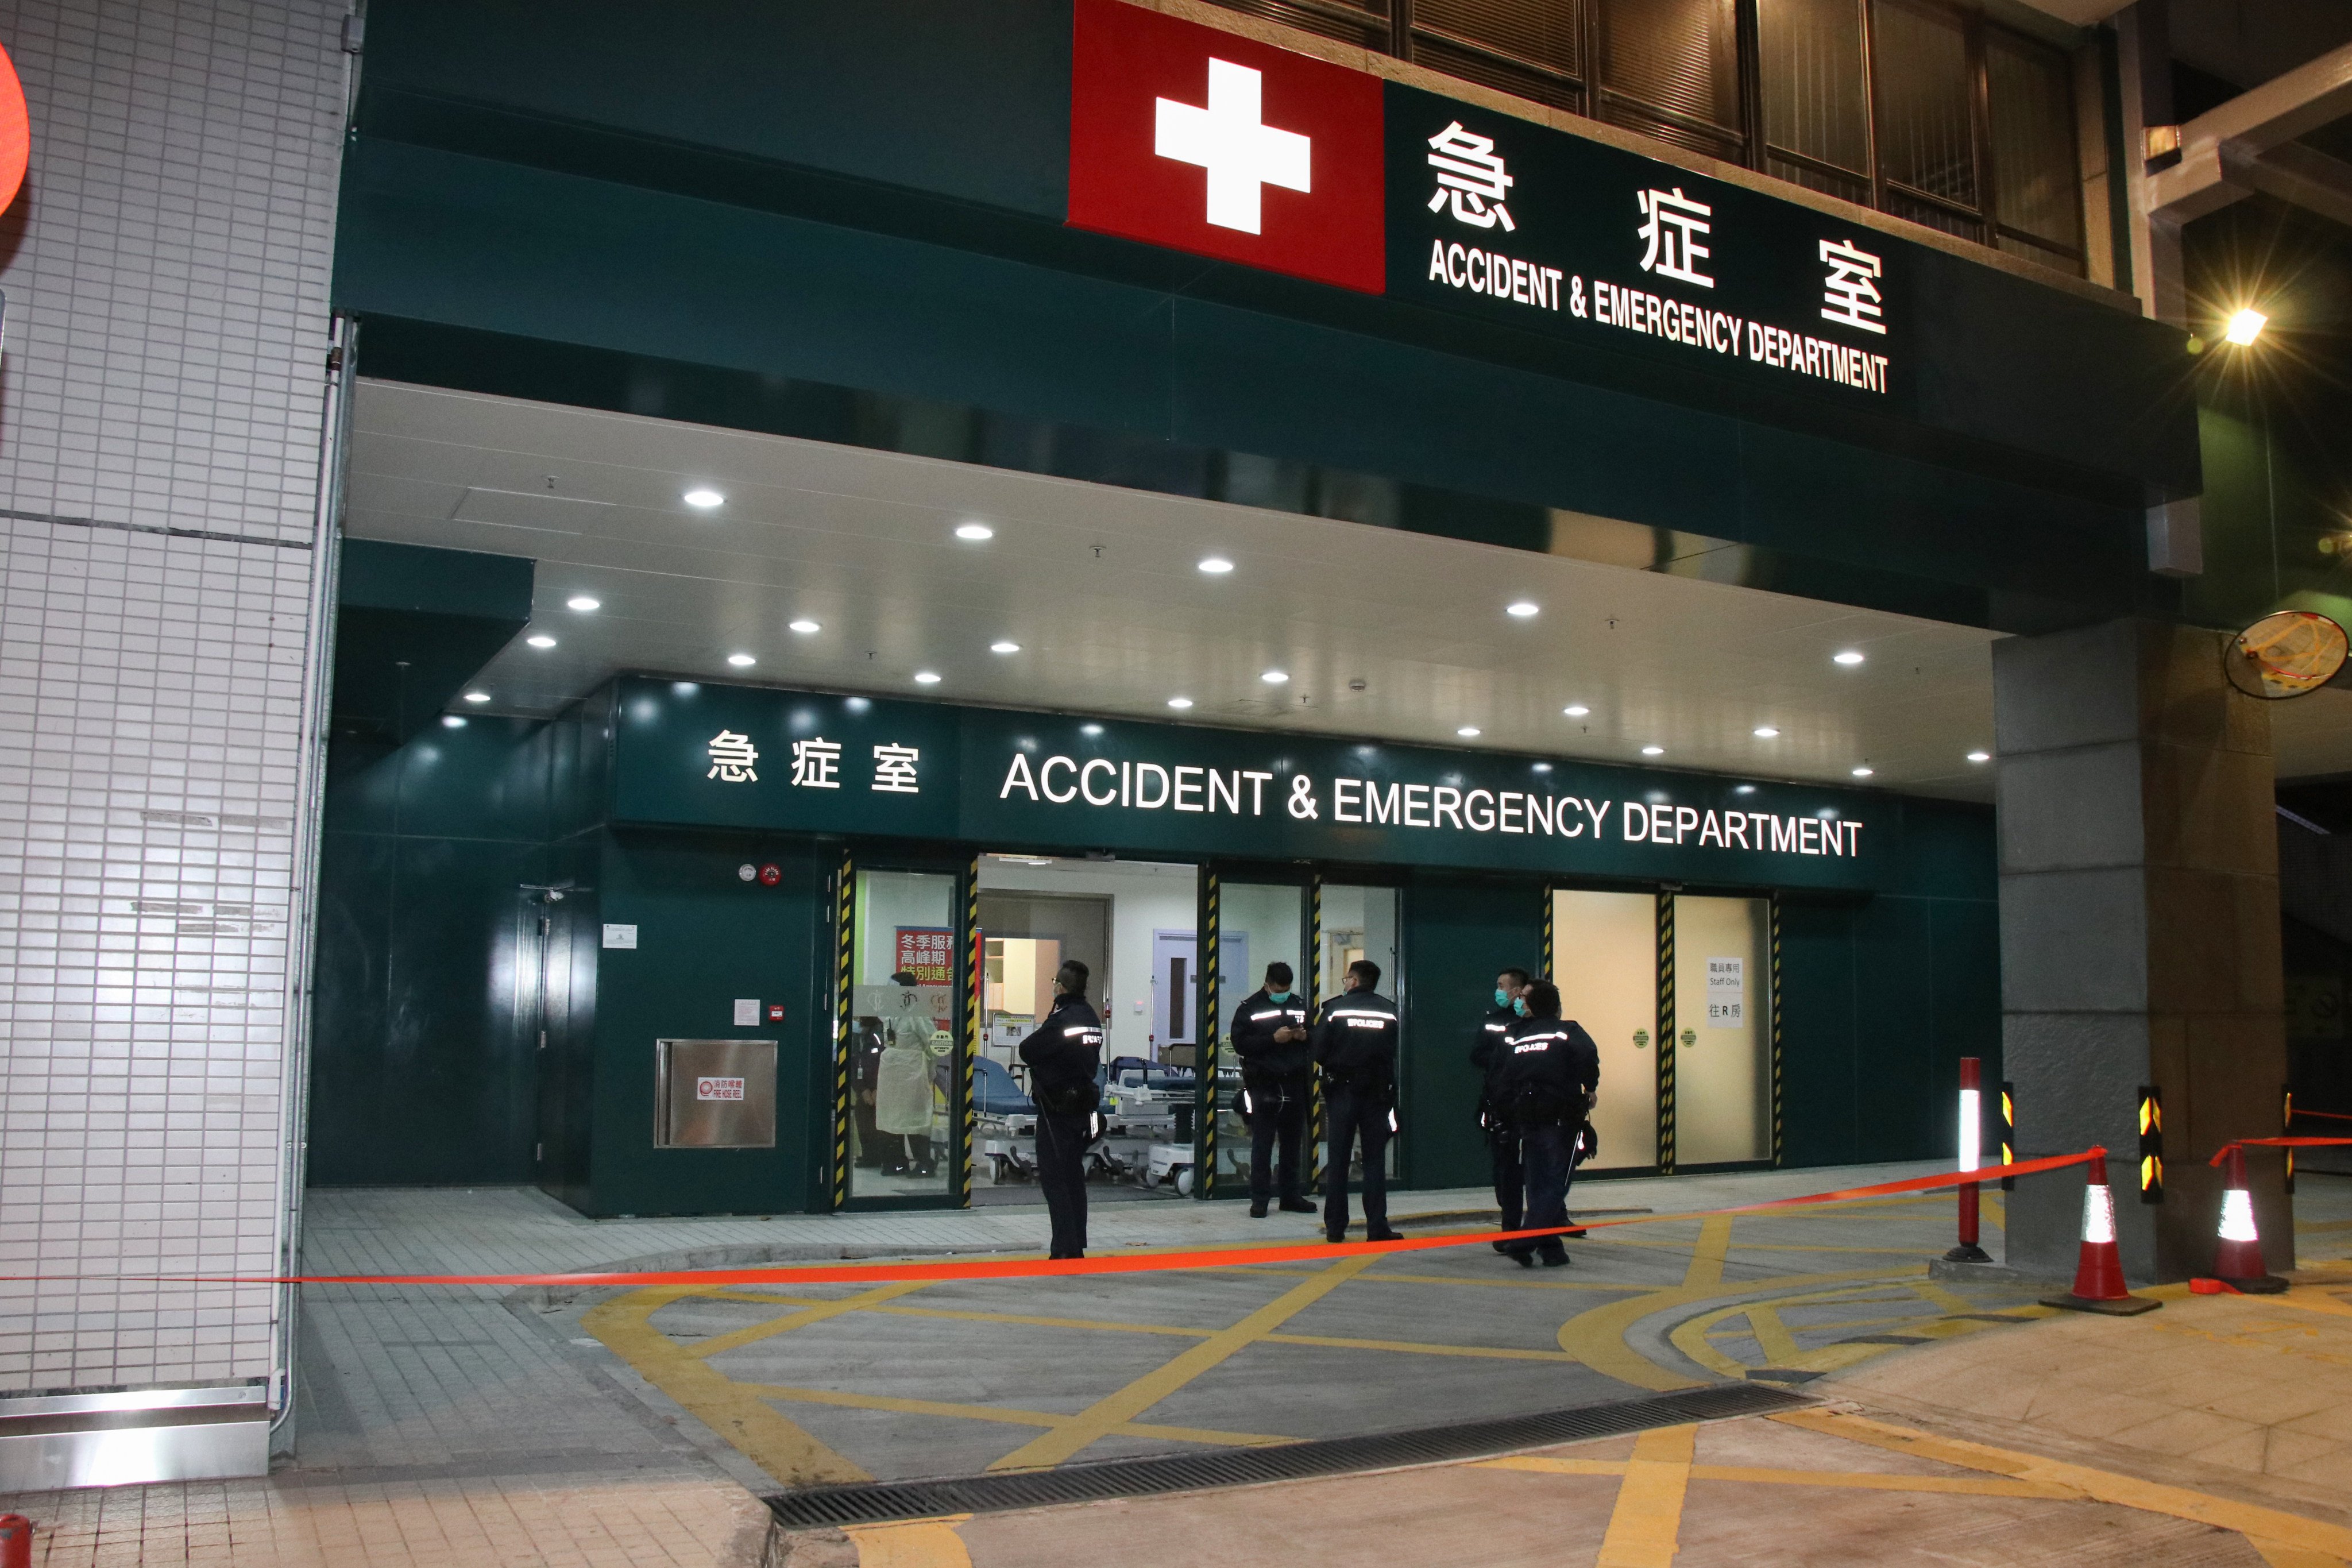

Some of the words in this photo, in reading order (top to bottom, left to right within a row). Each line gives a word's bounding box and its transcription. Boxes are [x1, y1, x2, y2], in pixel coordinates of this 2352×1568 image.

[1427, 121, 1887, 335] 急症室
[1428, 239, 1562, 311] ACCIDENT
[1570, 275, 1587, 318] &
[1594, 280, 1742, 356] EMERGENCY
[1748, 321, 1888, 394] DEPARTMENT
[707, 729, 919, 793] 急症室
[999, 753, 1273, 816] ACCIDENT
[1287, 774, 1319, 820] &
[1334, 778, 1611, 839] EMERGENCY
[1624, 802, 1863, 856] DEPARTMENT
[901, 950, 945, 965] 高峰期
[1710, 963, 1739, 973] 職員專用
[1710, 978, 1724, 986] Staff
[1726, 978, 1740, 987] Only
[1723, 1006, 1728, 1015] R
[1732, 1004, 1741, 1018] 房
